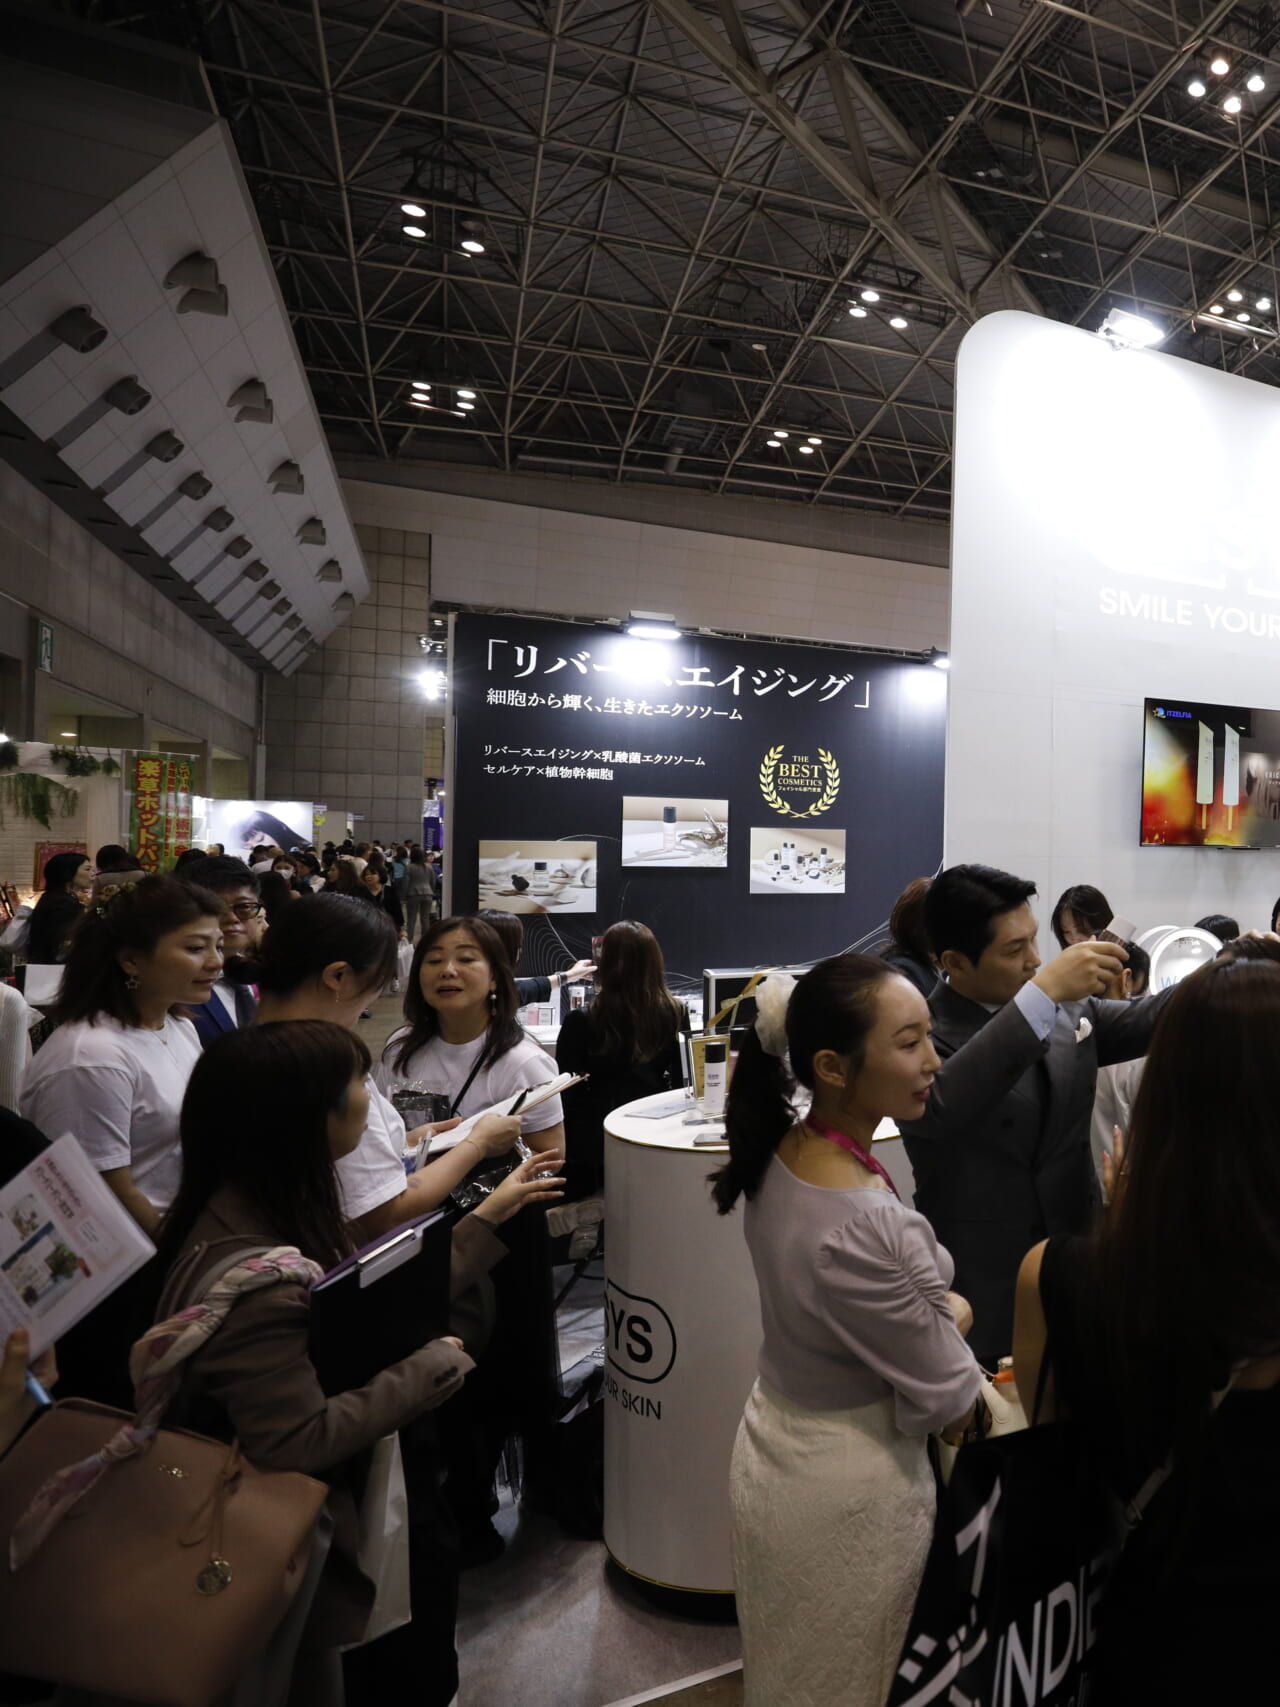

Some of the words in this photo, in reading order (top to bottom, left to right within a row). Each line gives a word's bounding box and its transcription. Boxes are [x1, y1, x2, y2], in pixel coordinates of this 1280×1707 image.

[1099, 587, 1193, 626] SMILE
[486, 687, 743, 721] 細胞から輝く、生きたエクソソーム
[484, 745, 706, 766] リバースエイジング×乳酸菌エクソソーム
[483, 764, 614, 781] セルケア×植物幹細胞
[777, 777, 822, 786] COSMETICS
[779, 763, 822, 778] BEST
[604, 1290, 652, 1363] YS
[622, 1389, 661, 1420] SKIN
